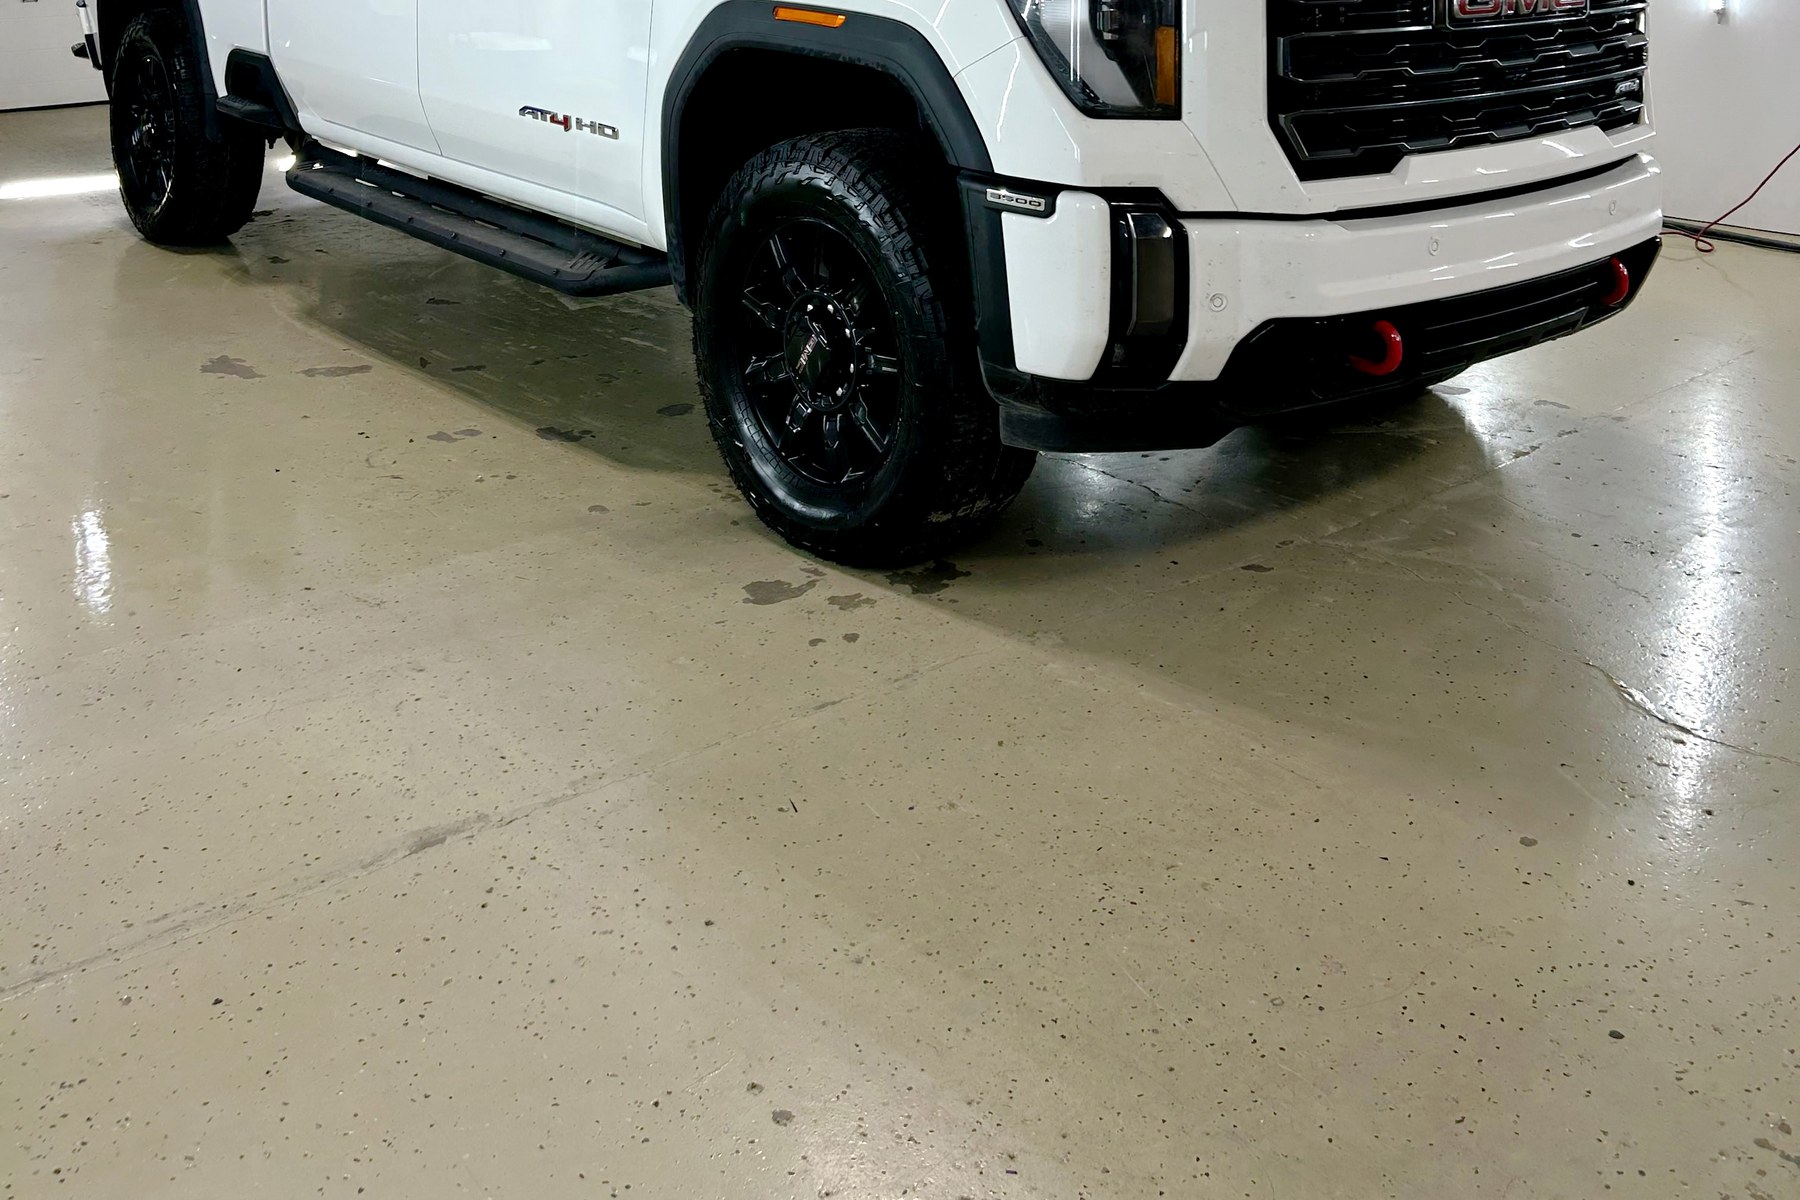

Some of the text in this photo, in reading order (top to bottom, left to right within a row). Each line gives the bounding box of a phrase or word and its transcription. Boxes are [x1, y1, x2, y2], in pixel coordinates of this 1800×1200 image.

[518, 105, 619, 140] AT4 HD
[989, 192, 1042, 208] 3500
